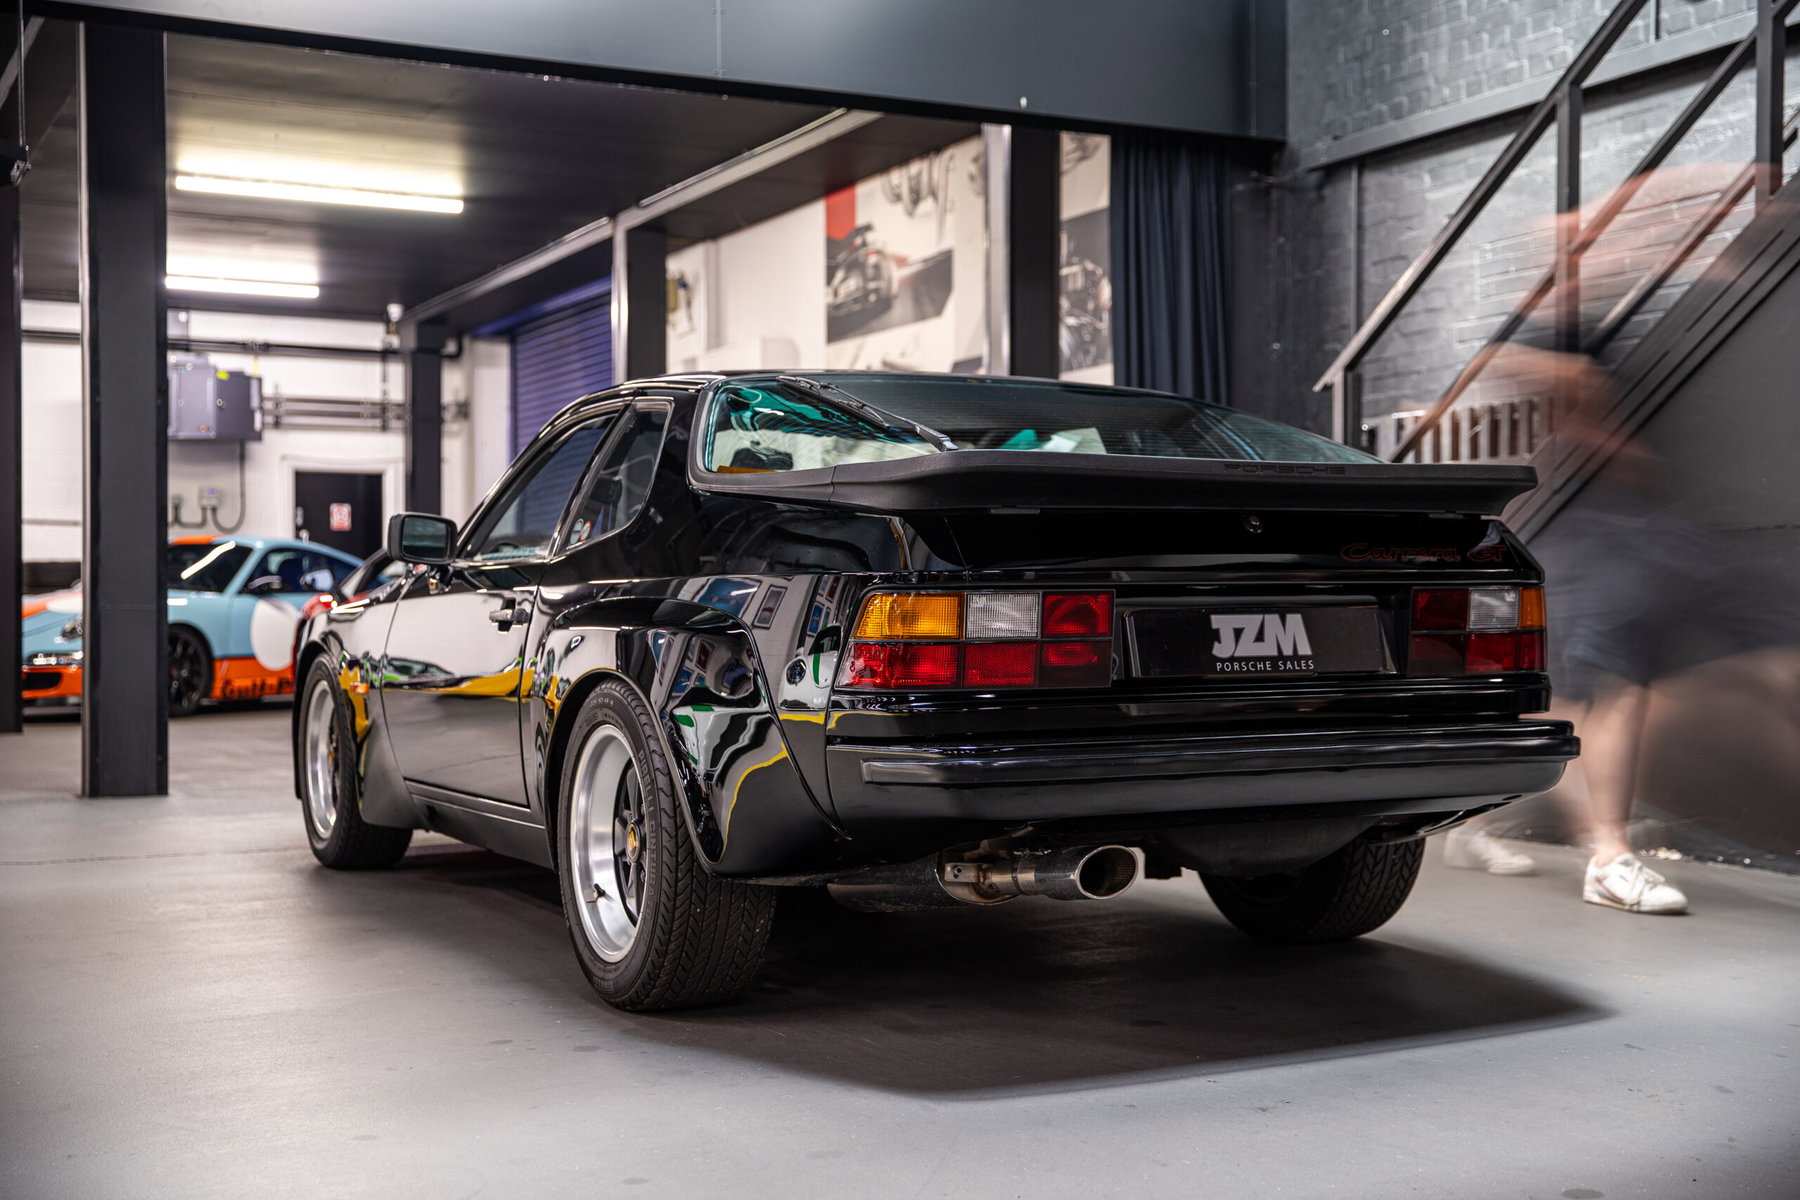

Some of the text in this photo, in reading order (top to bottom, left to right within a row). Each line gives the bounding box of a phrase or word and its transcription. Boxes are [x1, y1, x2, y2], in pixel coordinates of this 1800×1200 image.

[1223, 463, 1346, 476] PORSCHE
[1340, 542, 1507, 562] Carrera GT
[1210, 613, 1313, 658] JZM
[1216, 660, 1315, 672] PORSCHE SALES
[638, 749, 654, 812] PIRELLI
